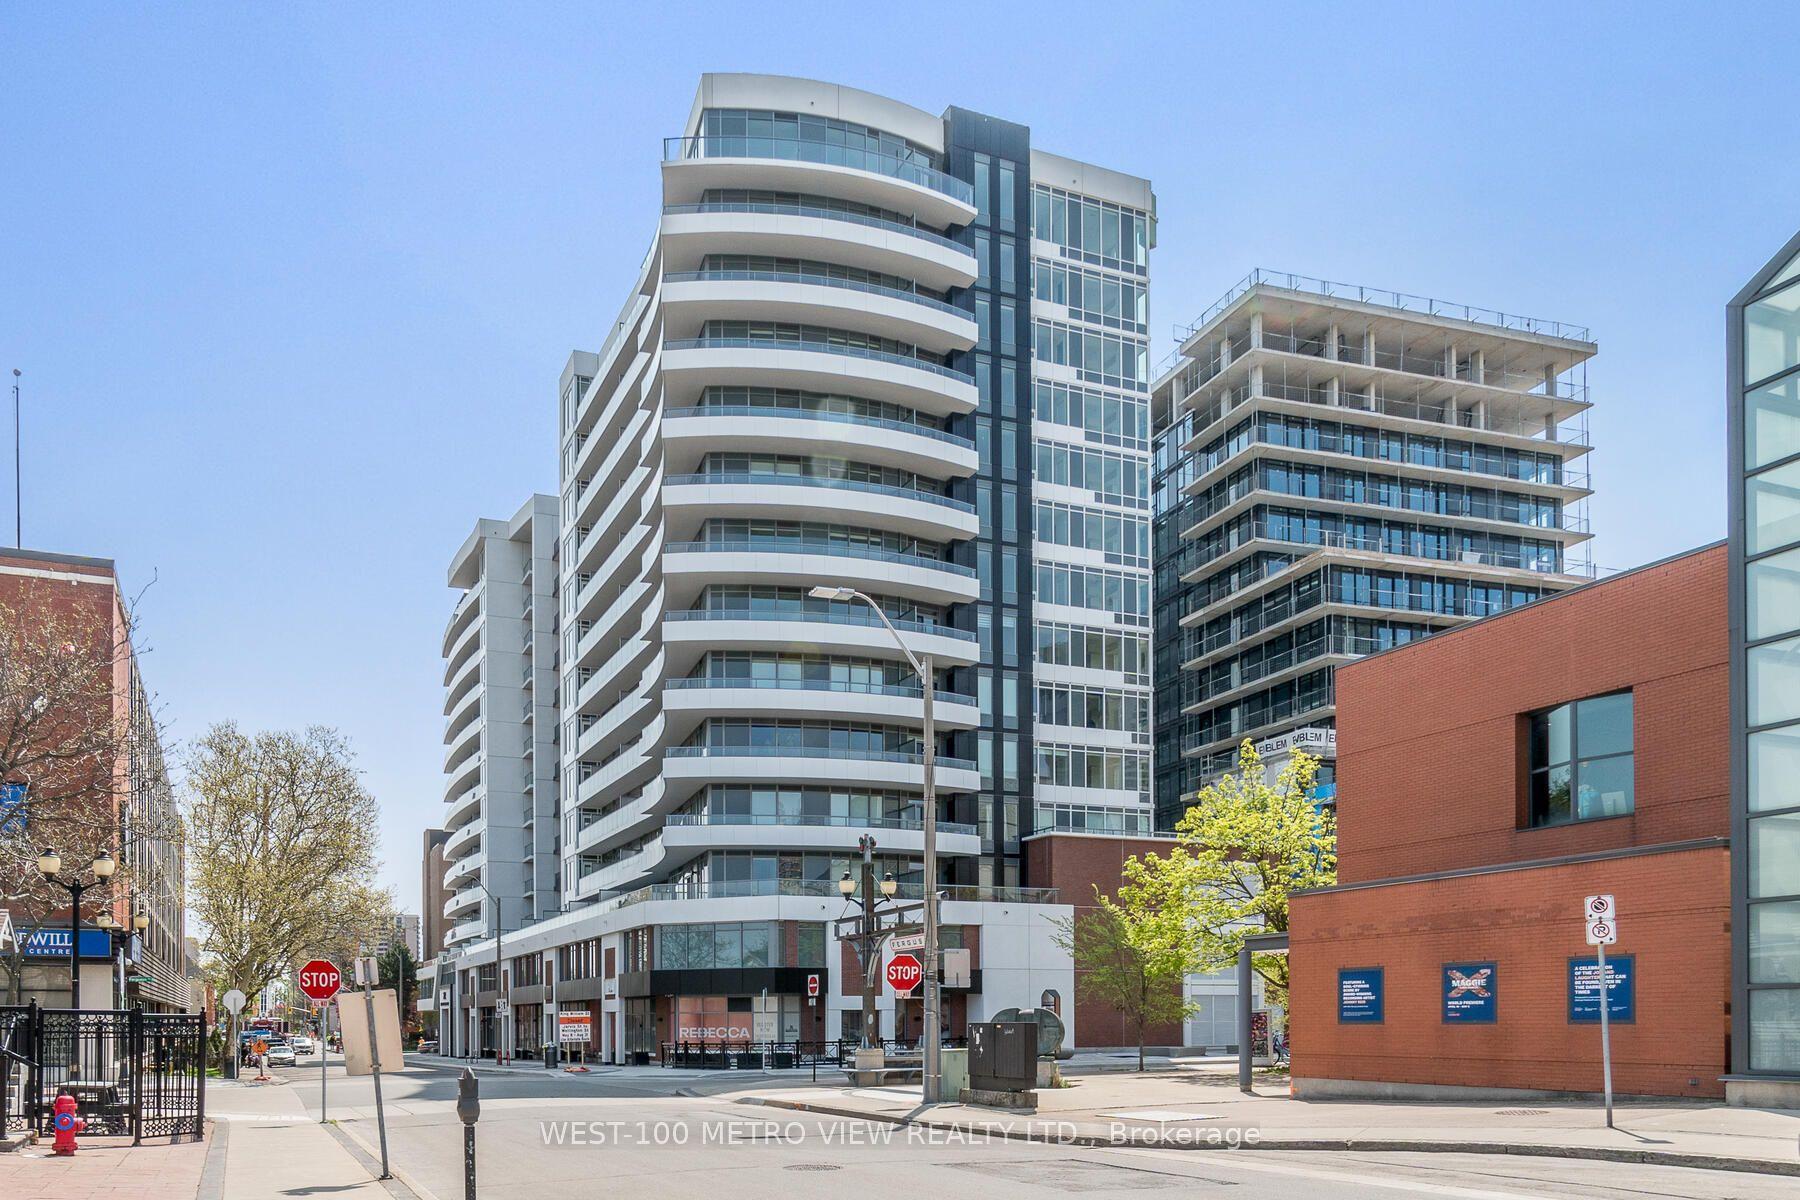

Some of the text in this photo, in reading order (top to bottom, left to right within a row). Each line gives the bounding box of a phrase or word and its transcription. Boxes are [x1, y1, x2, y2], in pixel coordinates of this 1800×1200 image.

[892, 938, 923, 948] FERGUS
[888, 966, 919, 980] STOP
[301, 972, 339, 988] STOP
[1451, 979, 1487, 987] MAGGIE
[679, 1027, 750, 1039] REBECCA
